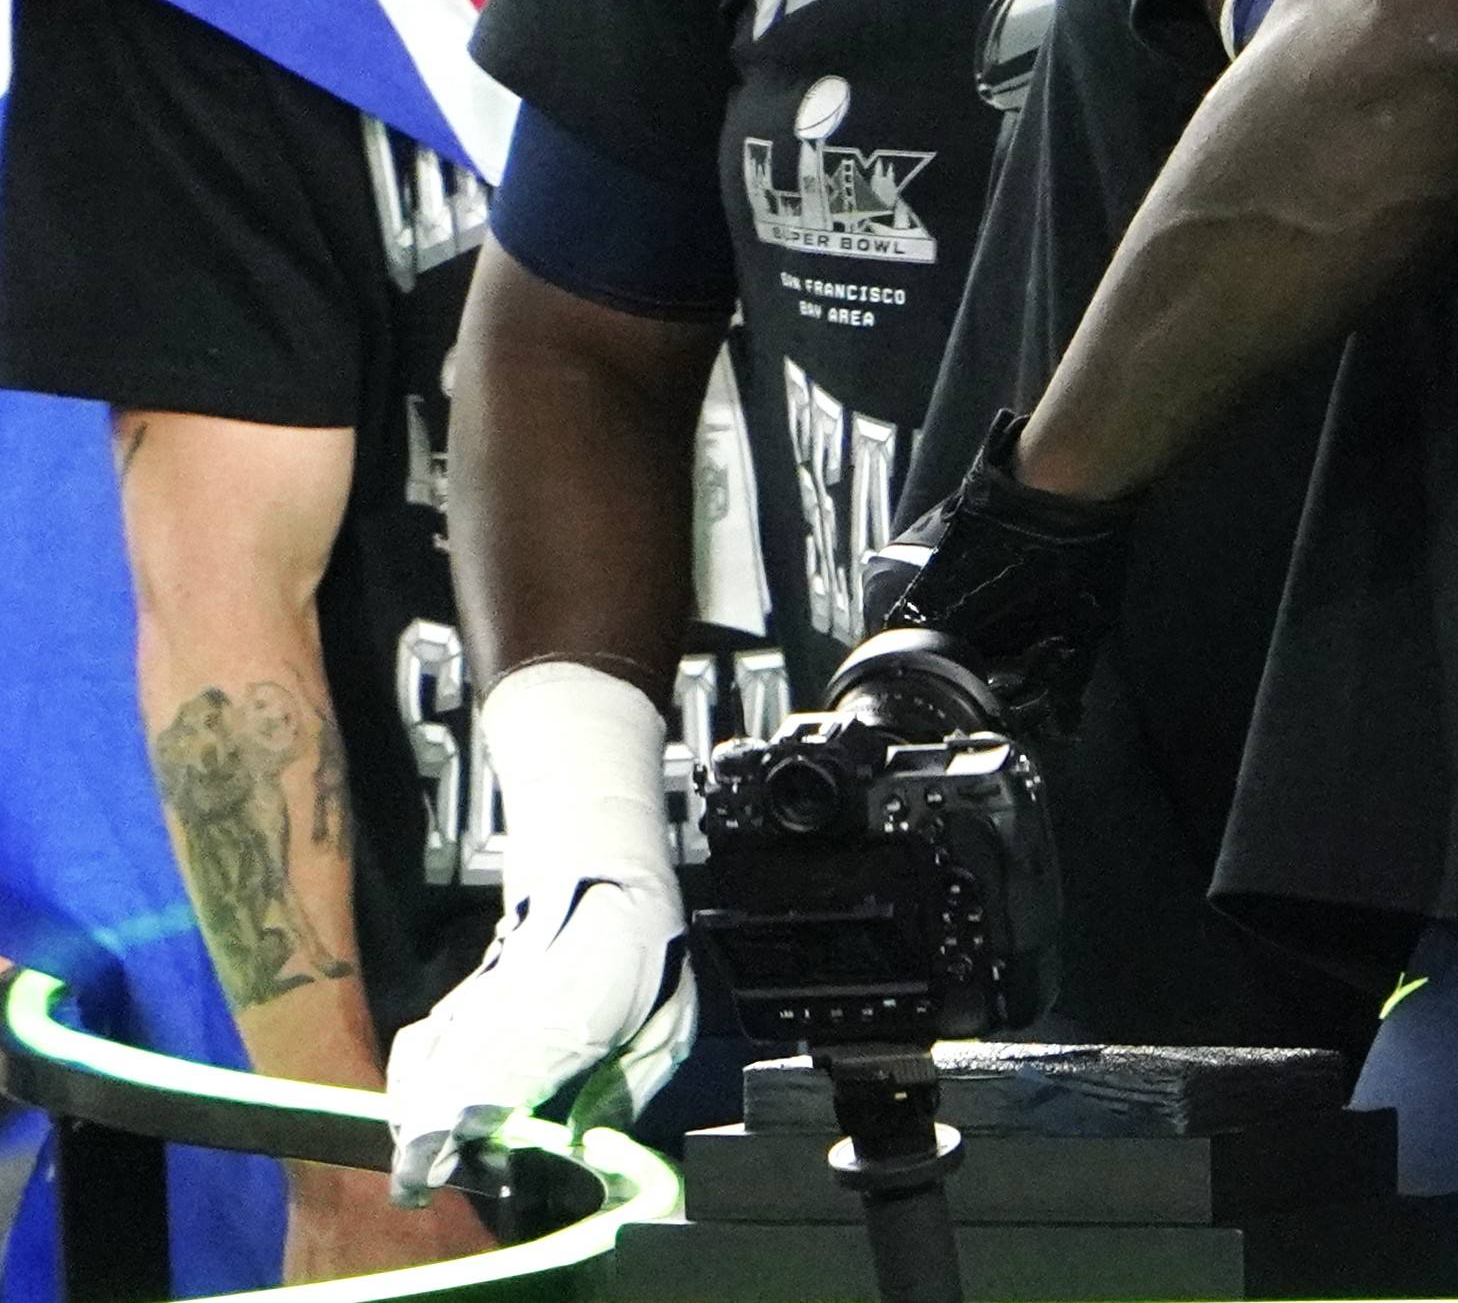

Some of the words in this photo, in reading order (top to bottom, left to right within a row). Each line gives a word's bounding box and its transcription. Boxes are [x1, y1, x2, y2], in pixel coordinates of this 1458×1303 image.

[838, 236, 907, 255] BOWL
[803, 277, 908, 306] FRANCISCO
[826, 306, 877, 328] AREA
